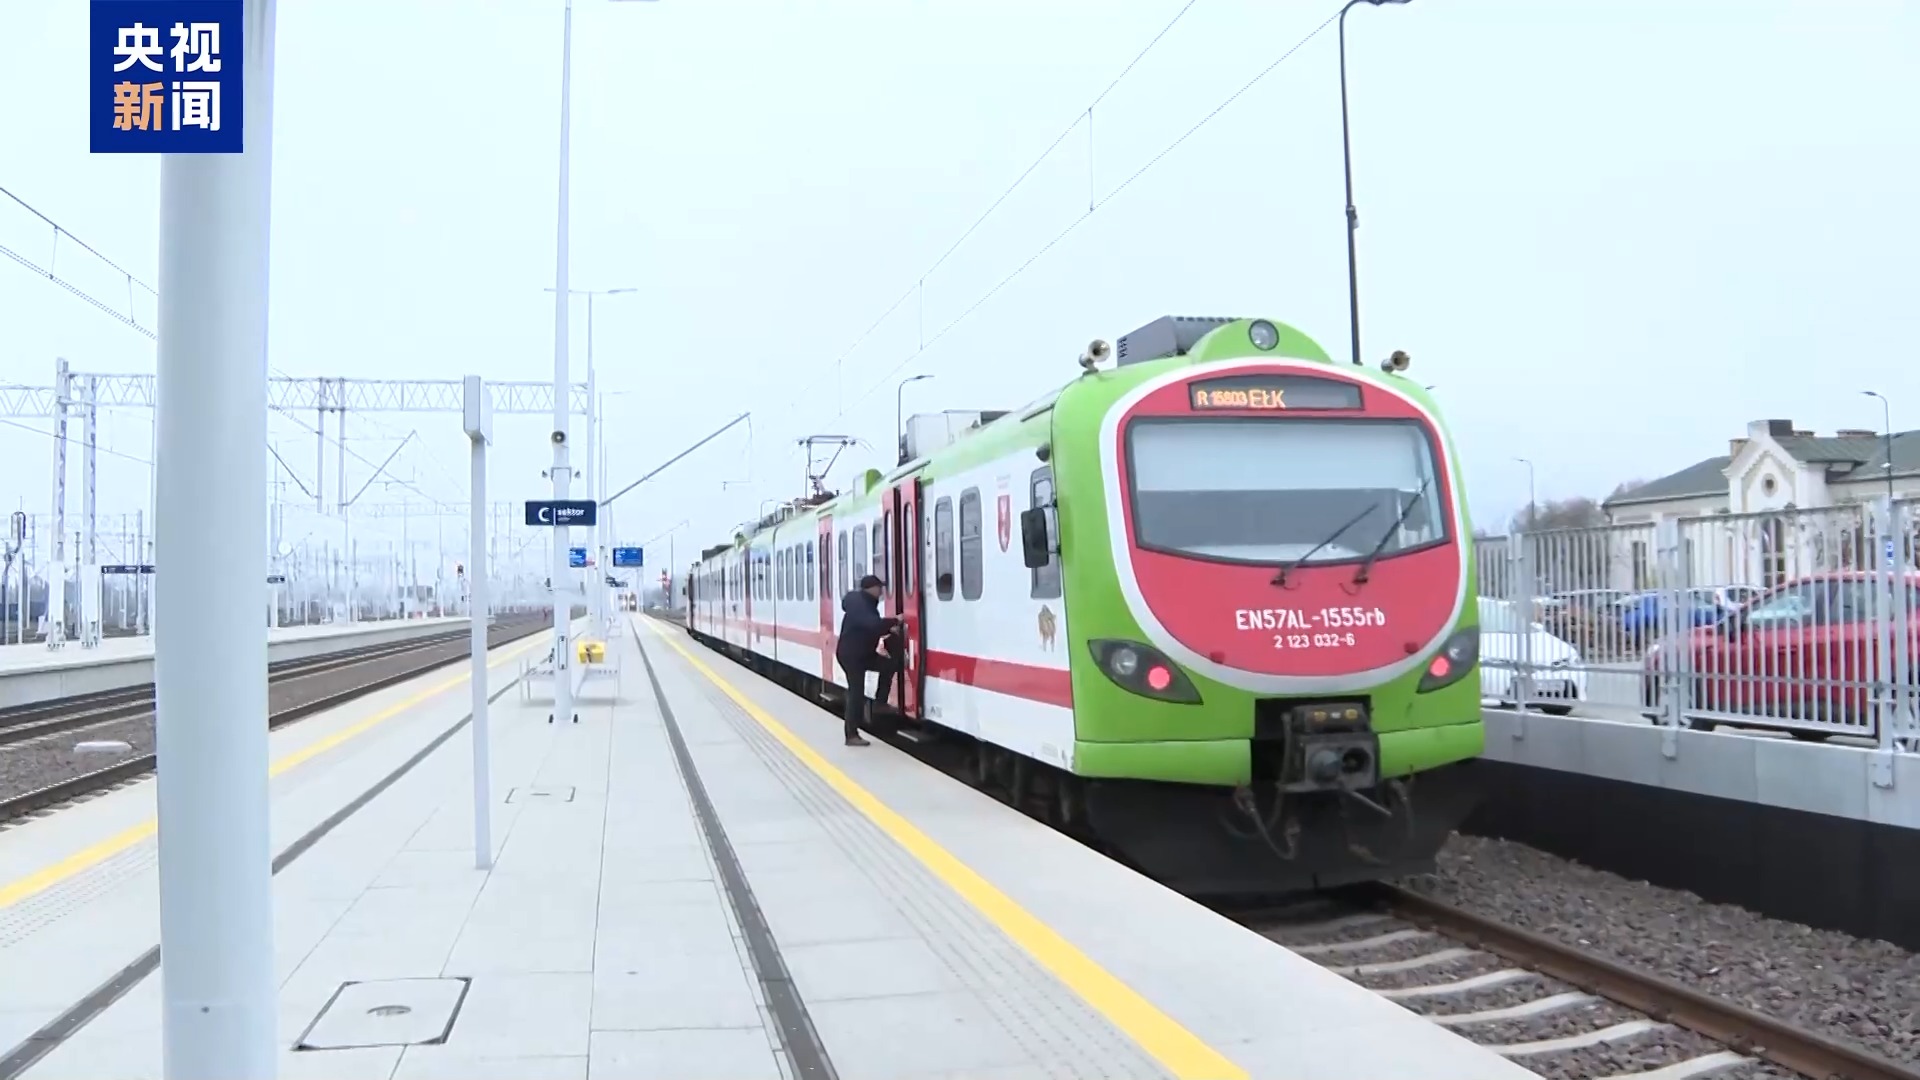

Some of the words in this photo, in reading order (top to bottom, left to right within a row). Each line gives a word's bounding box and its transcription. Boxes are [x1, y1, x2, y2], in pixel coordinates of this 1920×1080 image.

[1197, 390, 1209, 406] R
[538, 507, 550, 522] C
[557, 508, 585, 516] sektor
[1235, 607, 1385, 630] EN57AL-1555rb
[1273, 635, 1283, 649] 2
[1287, 635, 1310, 648] 123
[1314, 633, 1355, 647] 032-6
